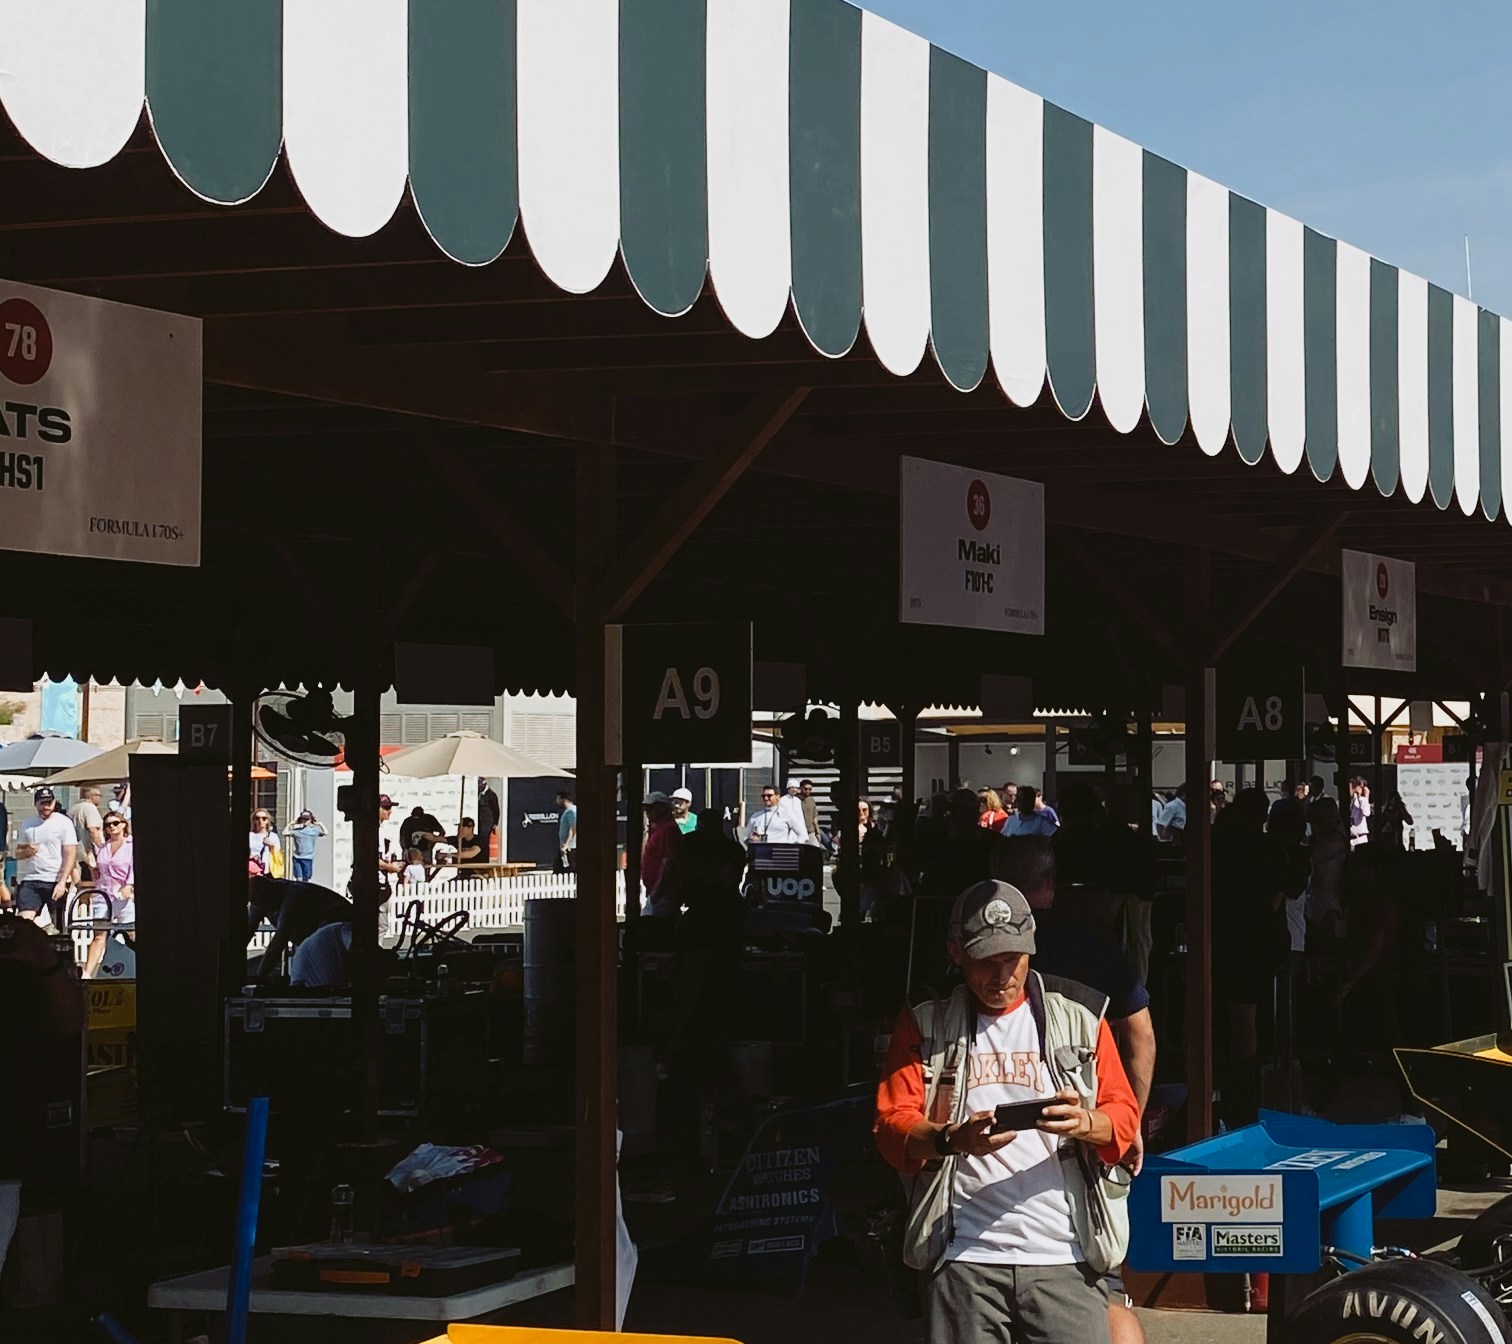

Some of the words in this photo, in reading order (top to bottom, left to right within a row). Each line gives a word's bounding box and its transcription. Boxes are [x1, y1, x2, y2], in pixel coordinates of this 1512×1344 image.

[5, 322, 38, 361] 78
[972, 494, 985, 517] 36
[90, 517, 149, 538] FORMULA
[957, 538, 1001, 565] Maki
[652, 666, 721, 721] A9
[1236, 695, 1284, 732] A8
[190, 723, 219, 748] B7
[869, 735, 892, 754] B5
[1167, 1180, 1275, 1217] Marigold
[1215, 1230, 1279, 1246] Masters
